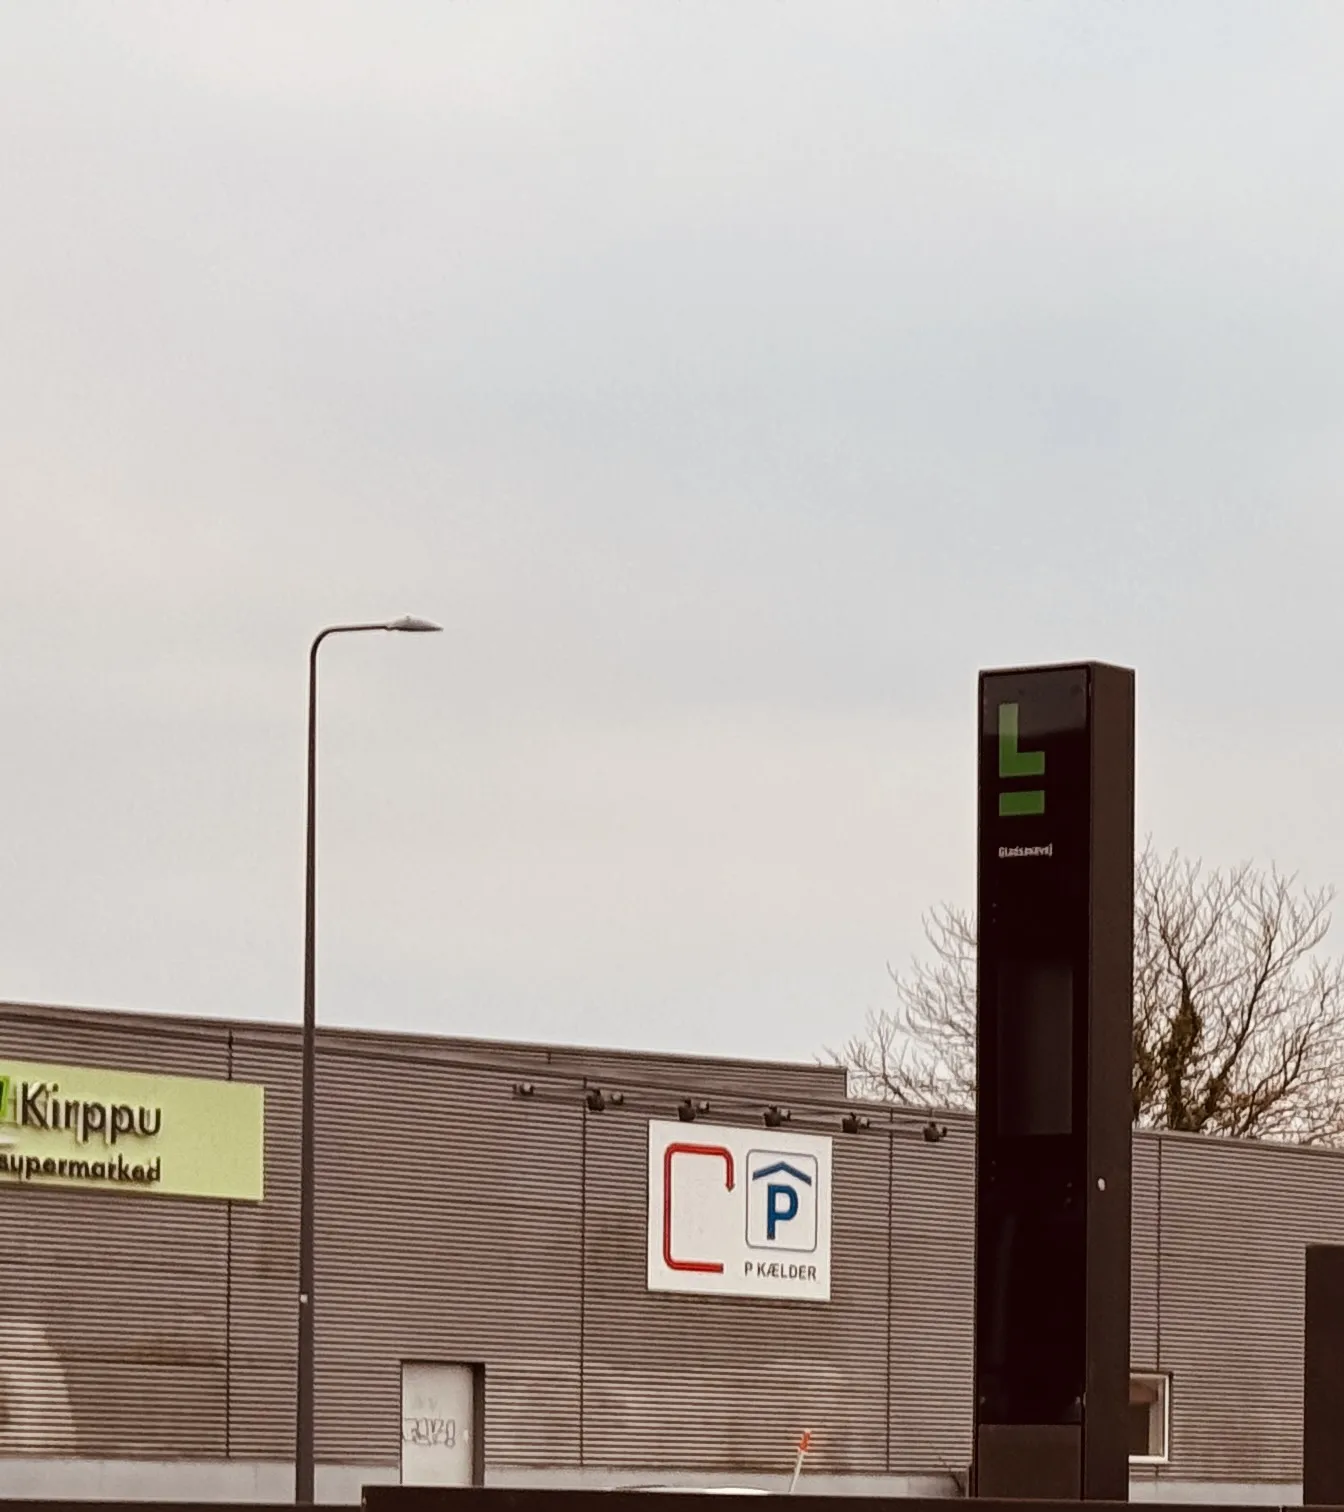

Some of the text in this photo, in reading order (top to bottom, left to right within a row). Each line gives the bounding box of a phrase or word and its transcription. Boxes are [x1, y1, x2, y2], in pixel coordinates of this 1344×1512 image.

[22, 1081, 161, 1144] Kirppu
[766, 1184, 798, 1240] P
[744, 1261, 817, 1281] P KÆLDER
